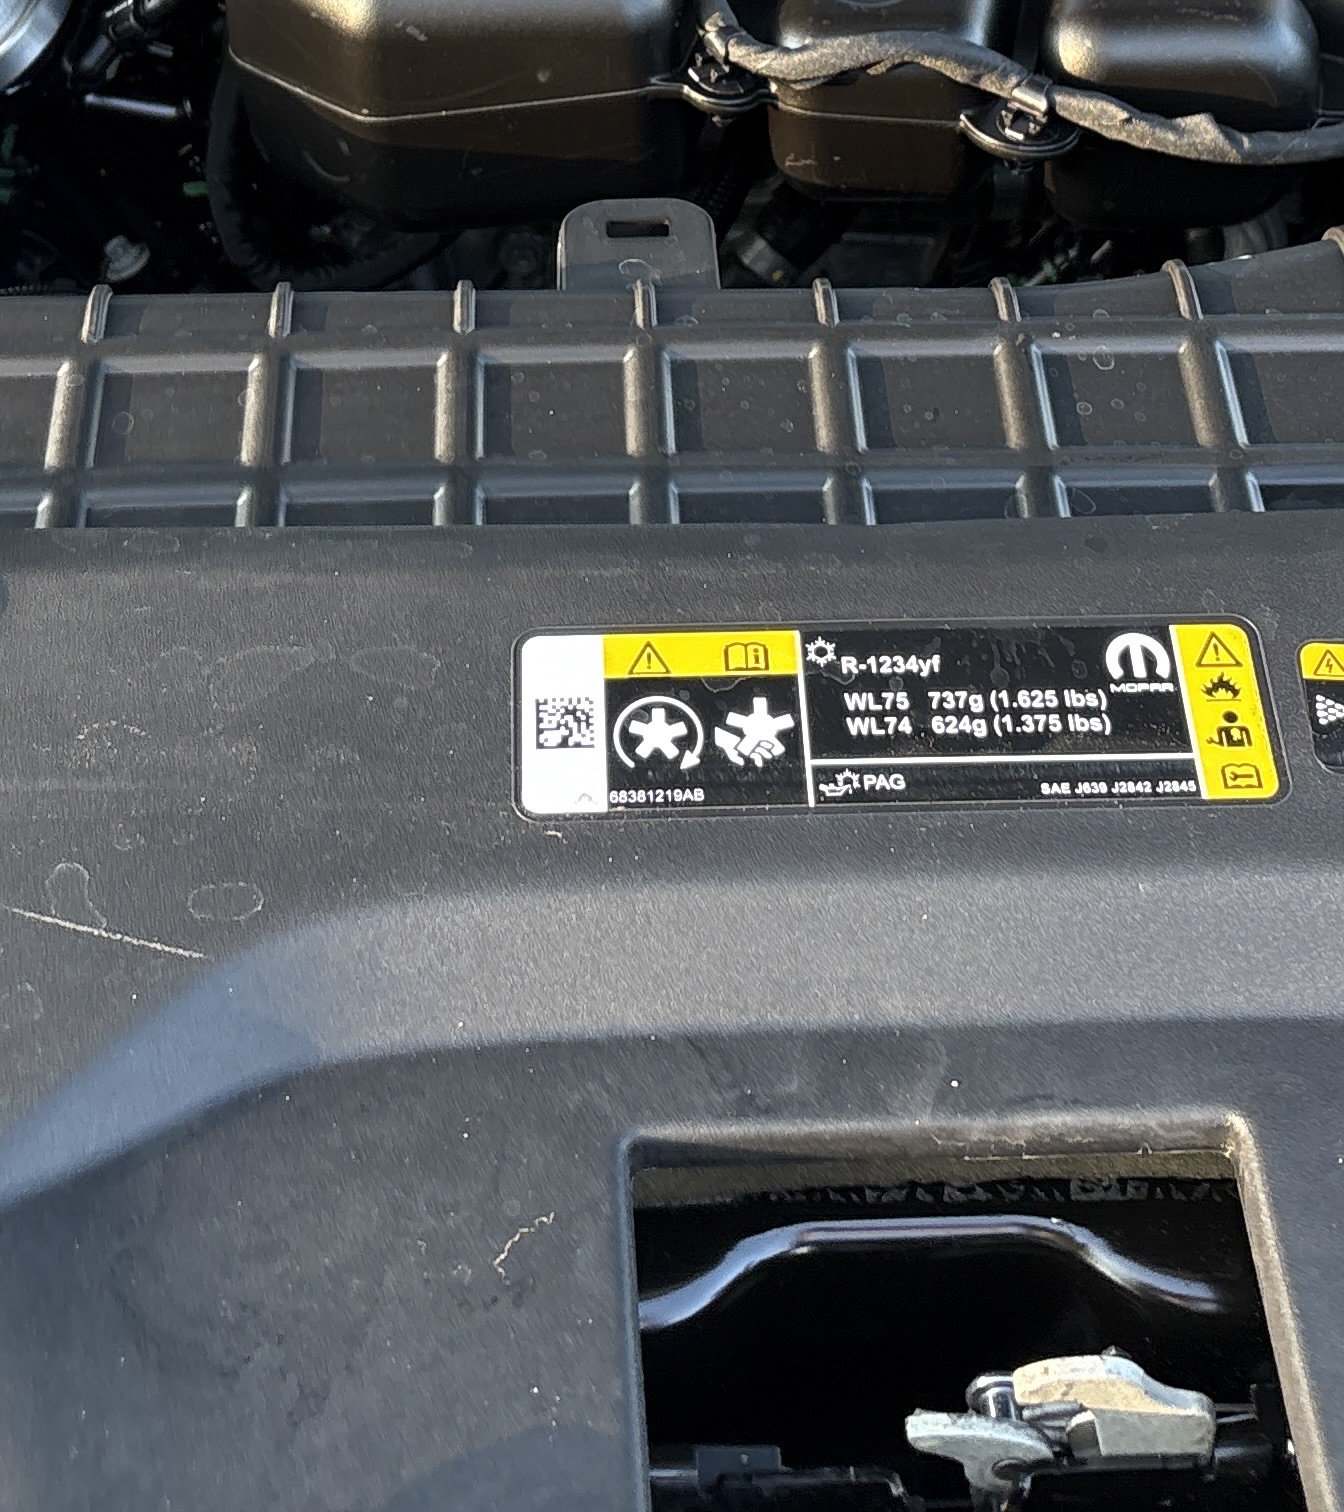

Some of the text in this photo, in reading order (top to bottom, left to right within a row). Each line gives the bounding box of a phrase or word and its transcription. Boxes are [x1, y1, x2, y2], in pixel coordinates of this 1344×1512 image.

[840, 654, 940, 677] R-1234yf
[1110, 682, 1174, 694] MOPAR
[844, 689, 1107, 713] WL75 737g (1.625 lbs)
[846, 713, 1111, 738] WL74 624g (1.375 lbs)
[863, 774, 906, 791] PAG
[1040, 782, 1071, 795] SAE
[1075, 781, 1108, 794] J639
[609, 788, 705, 803] 68381219AB
